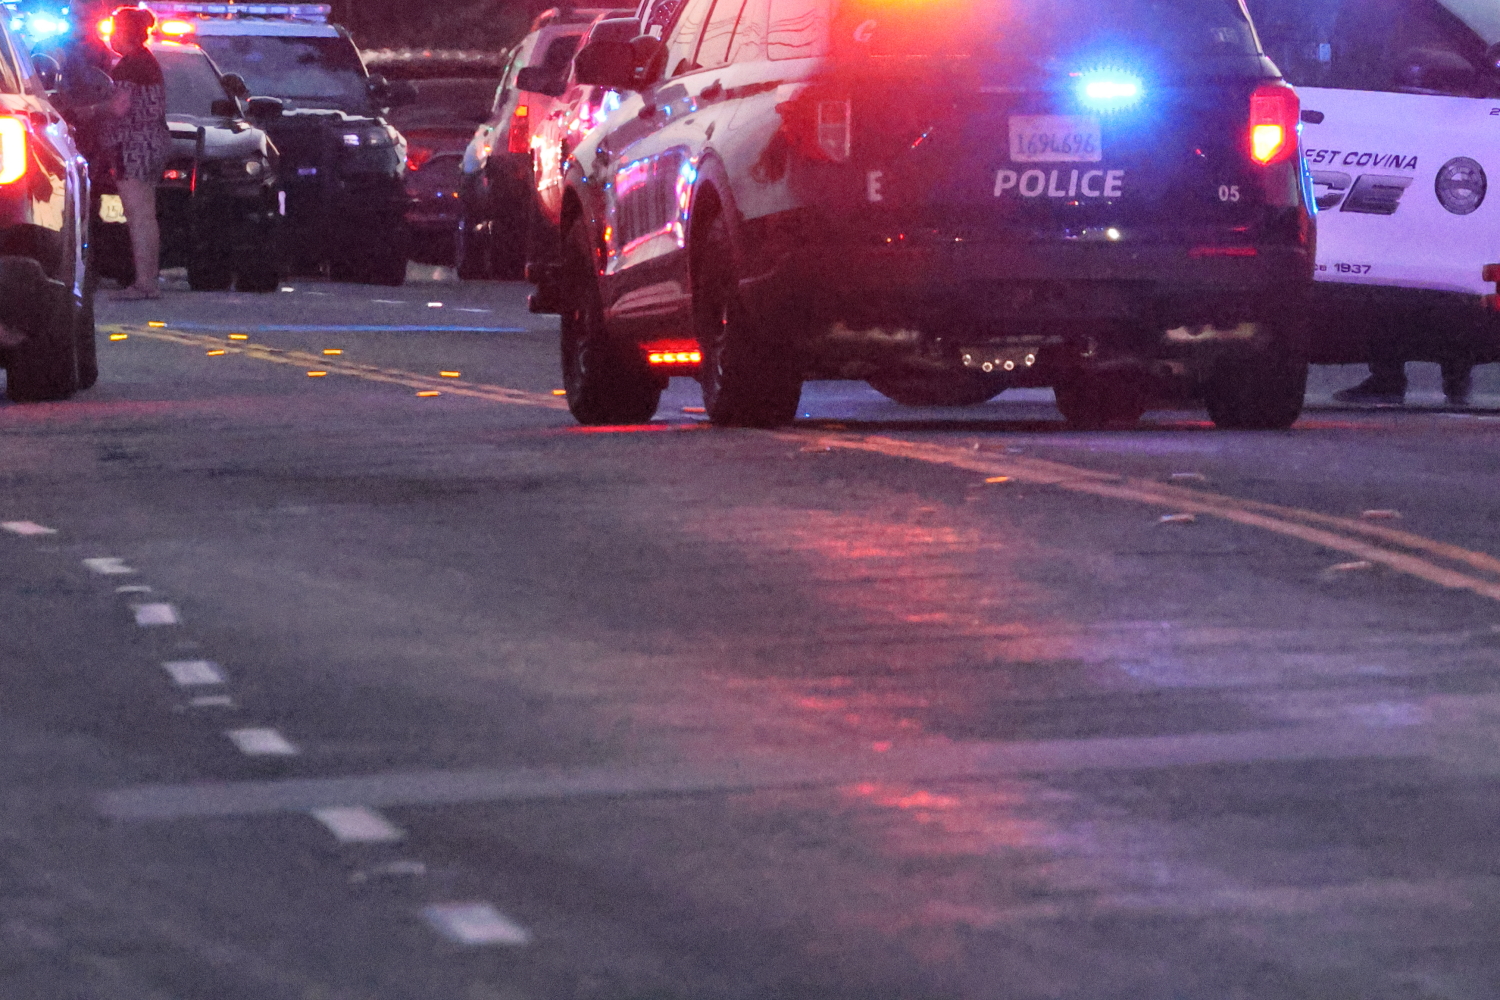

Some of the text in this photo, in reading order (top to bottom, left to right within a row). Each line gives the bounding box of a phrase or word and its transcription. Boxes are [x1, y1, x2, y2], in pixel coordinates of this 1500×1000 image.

[1305, 149, 1419, 170] EST COVINA
[993, 169, 1125, 198] POLICE
[1218, 184, 1240, 202] 05
[1334, 263, 1372, 275] 1937
